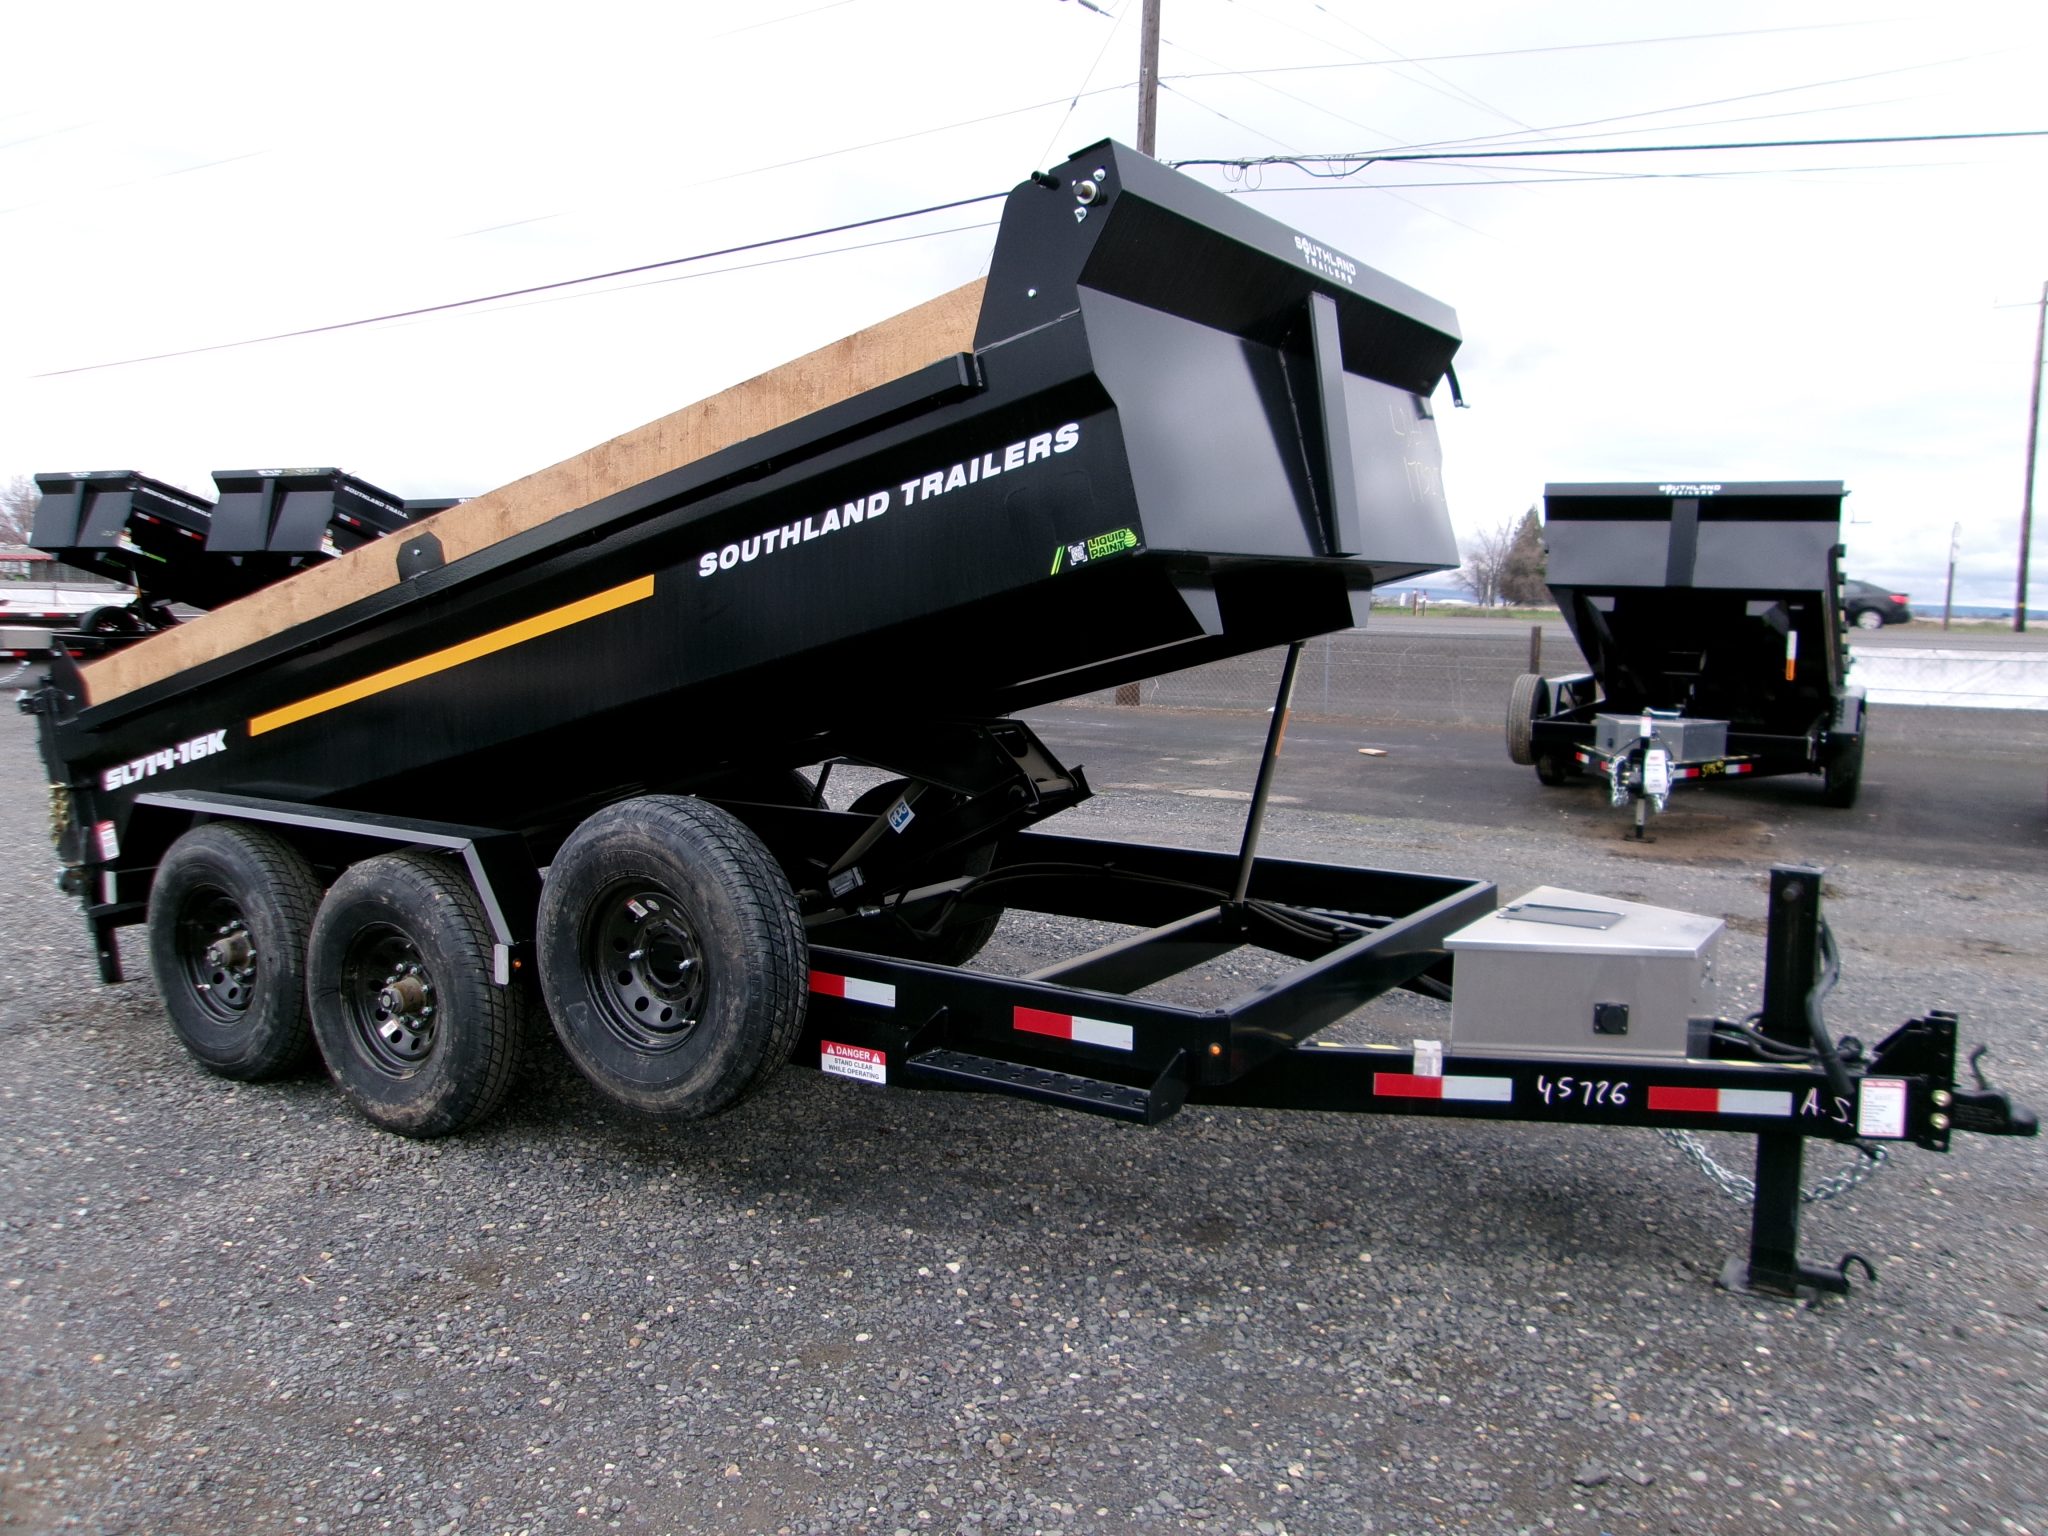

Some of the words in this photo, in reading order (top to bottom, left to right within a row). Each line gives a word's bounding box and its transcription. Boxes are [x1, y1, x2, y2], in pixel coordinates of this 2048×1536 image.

[1294, 236, 1356, 276] SOUTHLAND
[1305, 255, 1352, 284] TRAILERS
[698, 490, 890, 577] SOUTHLAND
[900, 422, 1079, 506] TRAILERS
[1088, 529, 1126, 549] LIQUID
[1090, 540, 1125, 559] PAINT
[103, 729, 228, 792] SL714-16K
[890, 802, 908, 826] PPG
[835, 1058, 852, 1066] STAND
[854, 1062, 872, 1070] CLEAR
[836, 1046, 870, 1060] DANGER
[828, 1064, 846, 1073] WHILE
[847, 1068, 879, 1079] OPERATING
